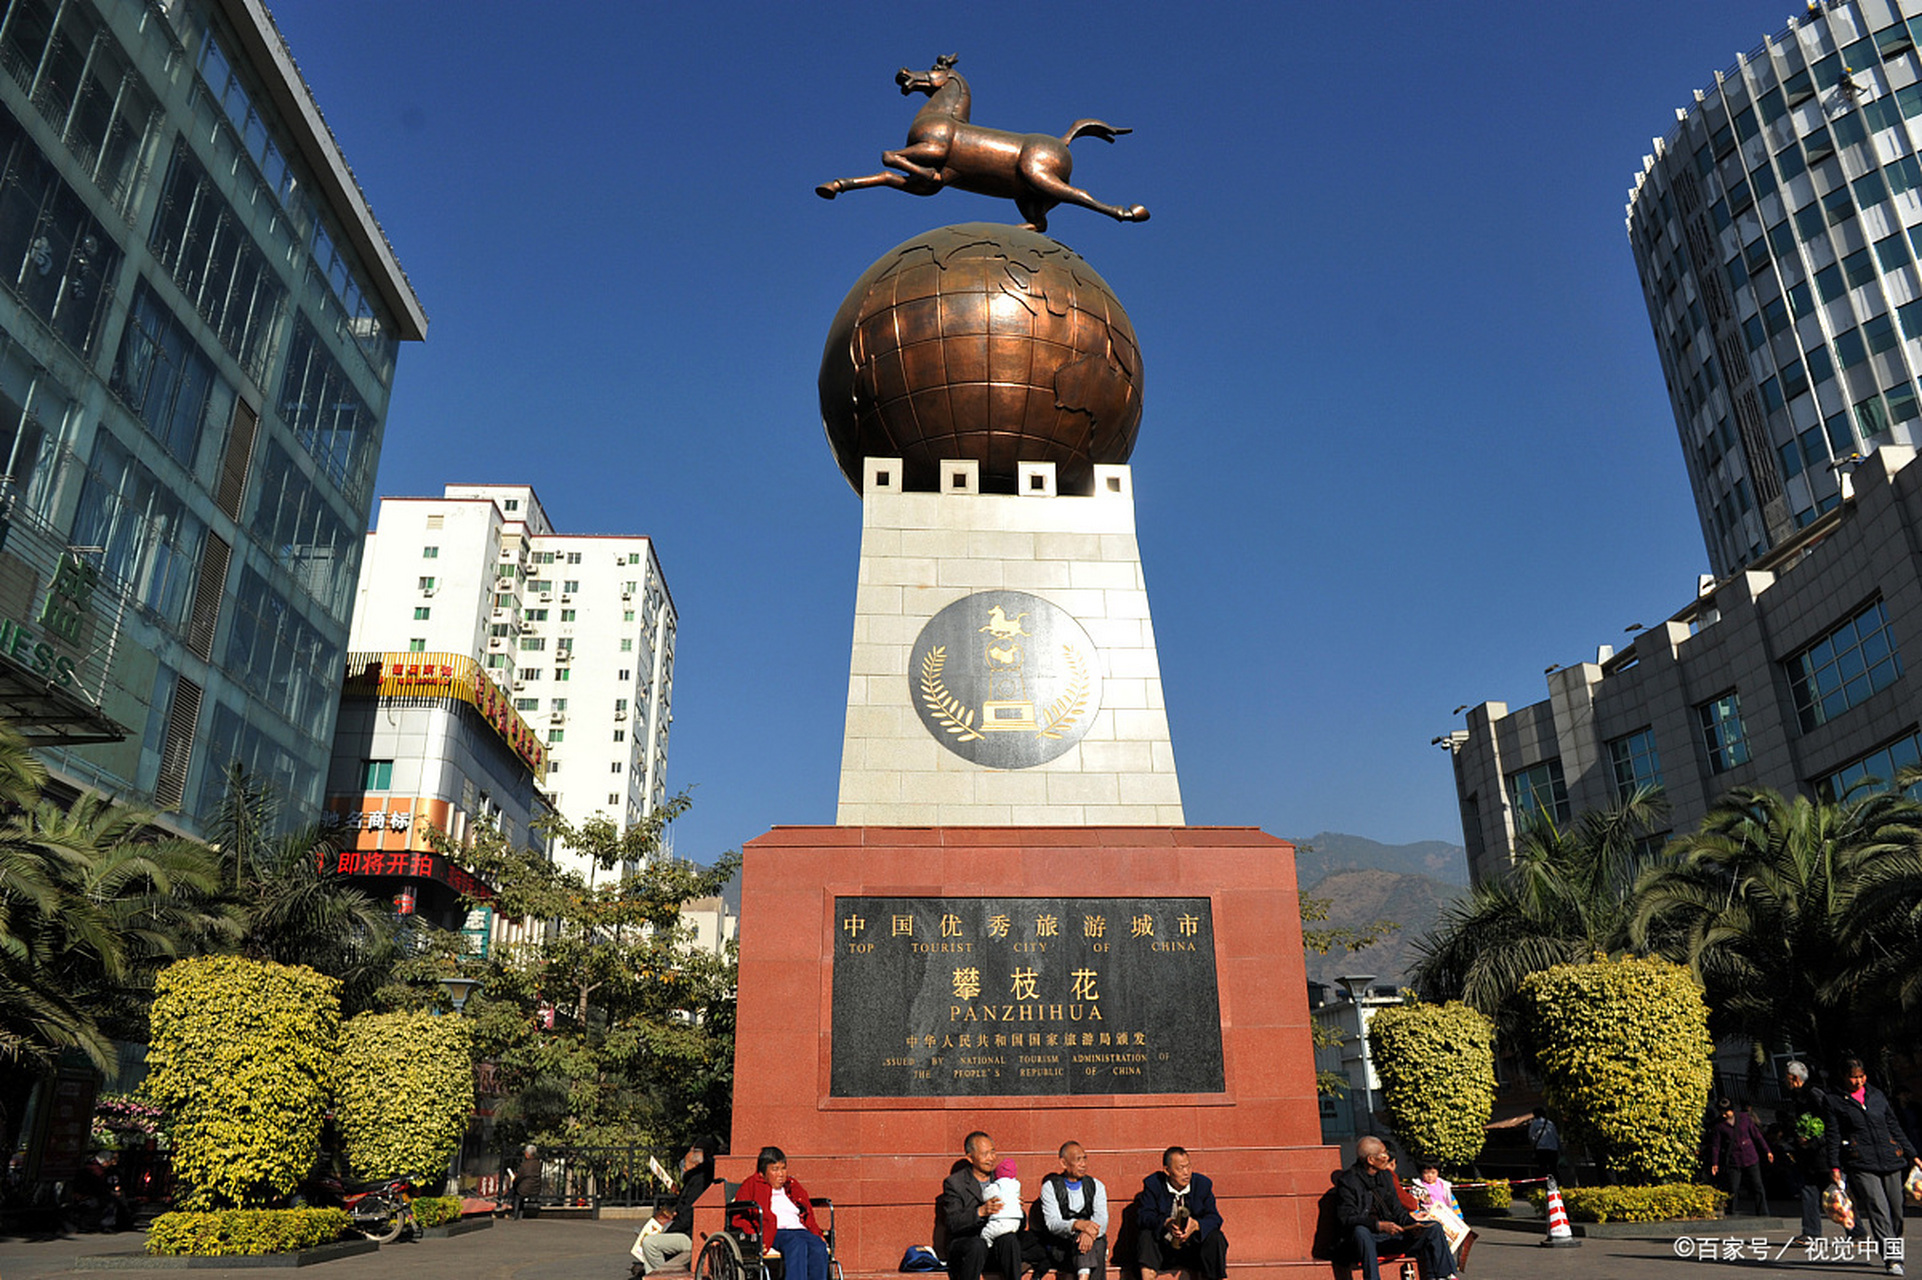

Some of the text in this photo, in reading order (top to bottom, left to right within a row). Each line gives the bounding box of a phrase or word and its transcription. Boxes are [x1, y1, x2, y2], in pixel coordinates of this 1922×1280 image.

[321, 810, 411, 830] 驰名商标
[843, 912, 1200, 938] 中国优秀旅游城市
[849, 941, 1197, 954] TOP TOURIST CITY OF CHINA
[951, 966, 1101, 1001] 攀枝花
[949, 1004, 1103, 1022] PANZHIHUA
[906, 1032, 1146, 1049] 中华人民共和国国家旅游局颁发
[882, 1052, 1171, 1067] SSUED BY NATIONAL TOURISM ADMINISTRATION OF
[914, 1069, 932, 1079] THE
[1020, 1067, 1064, 1077] REPUBLIC
[1085, 1067, 1097, 1077] OF
[1112, 1066, 1142, 1076] CHINA
